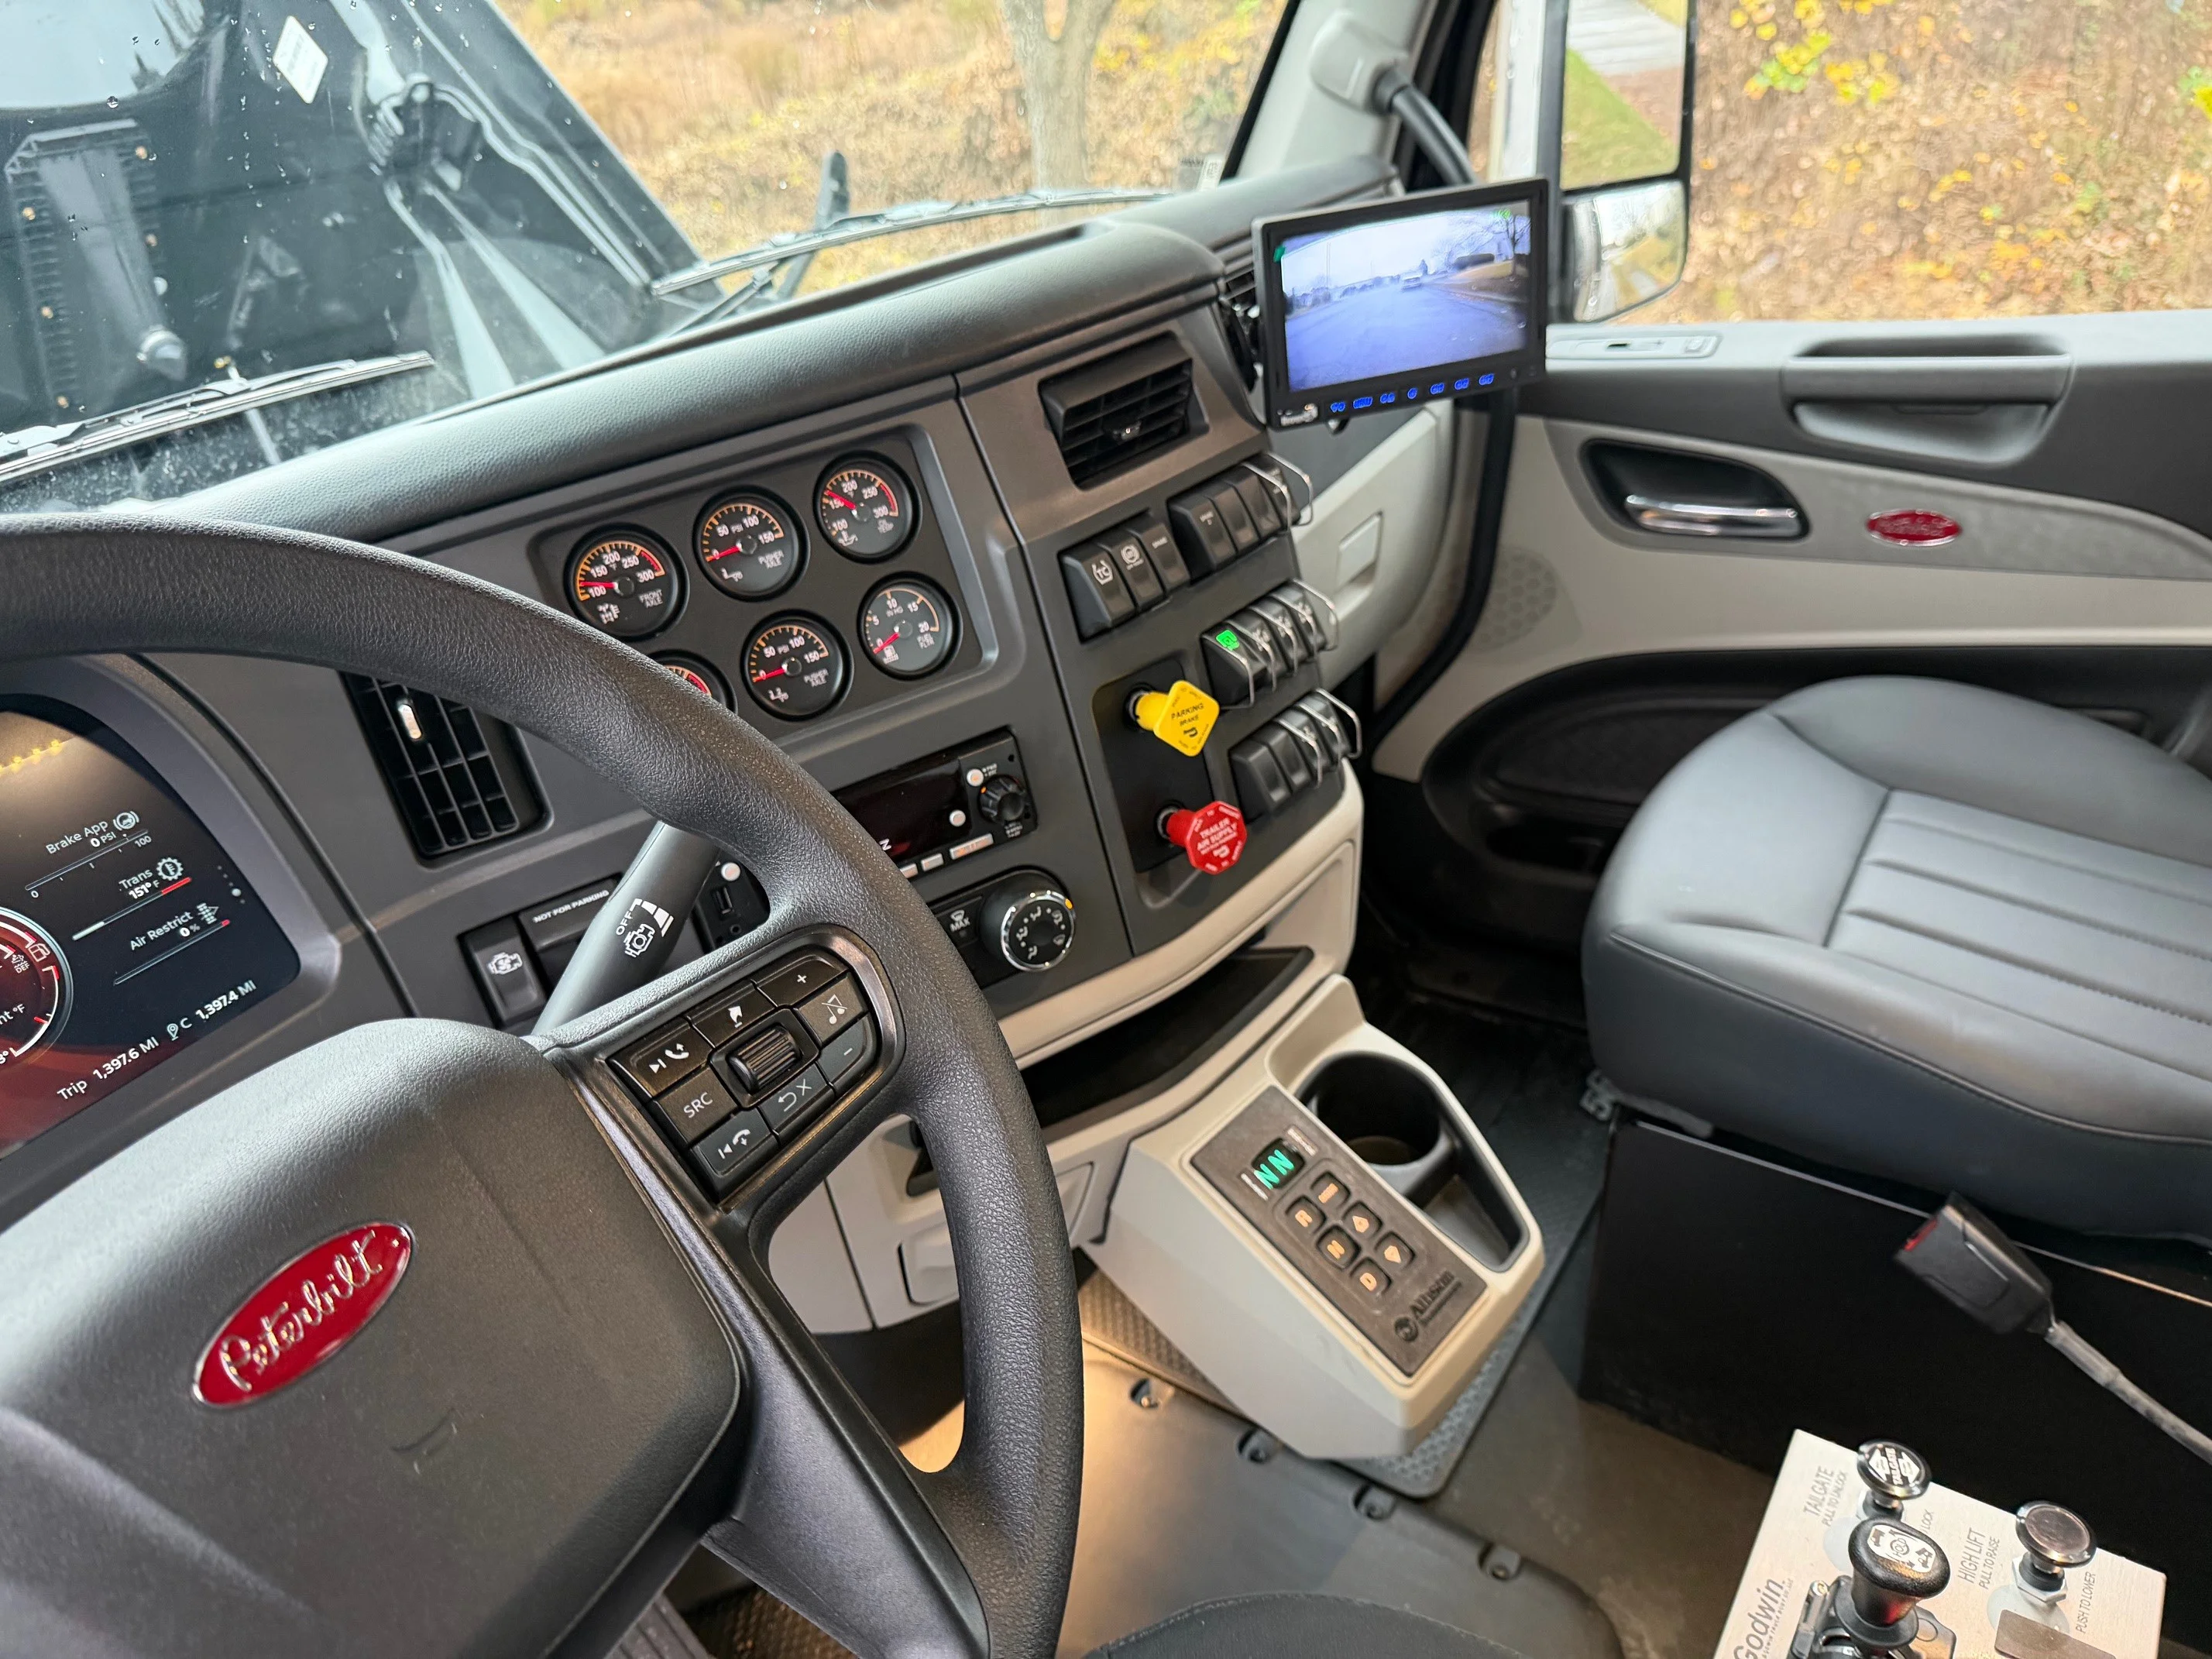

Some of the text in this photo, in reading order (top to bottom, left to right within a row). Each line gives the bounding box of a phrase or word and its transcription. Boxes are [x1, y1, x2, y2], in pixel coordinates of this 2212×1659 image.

[841, 479, 857, 493] 200
[861, 486, 878, 500] 250
[873, 505, 888, 518] 300
[743, 514, 759, 527] 100
[832, 518, 848, 532] 100
[716, 524, 729, 537] 50
[758, 531, 775, 544] 150
[603, 551, 620, 565] 200
[621, 555, 640, 568] 250
[590, 565, 608, 578] 150
[636, 569, 654, 582] 300
[589, 586, 606, 598] 100
[638, 589, 662, 603] FRONT
[645, 597, 663, 608] AXLE
[887, 598, 898, 610] 10
[908, 602, 919, 613] 15
[918, 620, 929, 633] 20
[789, 636, 805, 649] 100
[763, 646, 775, 658] 50
[804, 650, 820, 664] 150
[1171, 702, 1204, 720] PARKING
[1180, 714, 1199, 726] BRAKE
[1200, 817, 1231, 839] TRAILER
[1210, 822, 1238, 843] SUPPLY
[46, 820, 108, 854] Brake App
[90, 832, 116, 847] 0 PSI
[135, 835, 152, 848] 100
[118, 869, 153, 890] Trans
[153, 880, 160, 888] F
[30, 890, 39, 898] 0
[532, 890, 610, 923] NOT FOR PARKING
[616, 910, 634, 936] OFF
[950, 917, 970, 933] MAX
[129, 911, 194, 950] Air Restrict
[180, 927, 191, 937] 0
[15, 963, 30, 974] DEF
[180, 979, 257, 1029] C 1,397.4 MI
[57, 1036, 160, 1101] Trip 1,397.6 MI
[683, 1091, 713, 1118] SRC
[1295, 1210, 1313, 1228] R
[1359, 1273, 1377, 1291] D
[220, 1229, 383, 1391] Peterbilt
[1803, 1465, 1834, 1516] TAILGATE
[1822, 1471, 1848, 1527] PULL TO UNLOCK
[1921, 1509, 1934, 1530] LOCK
[1956, 1527, 1986, 1583] HIGH LIFT
[1979, 1536, 2000, 1589] PULL TO RAISE
[2076, 1571, 2096, 1633] PUSH TO LOWER
